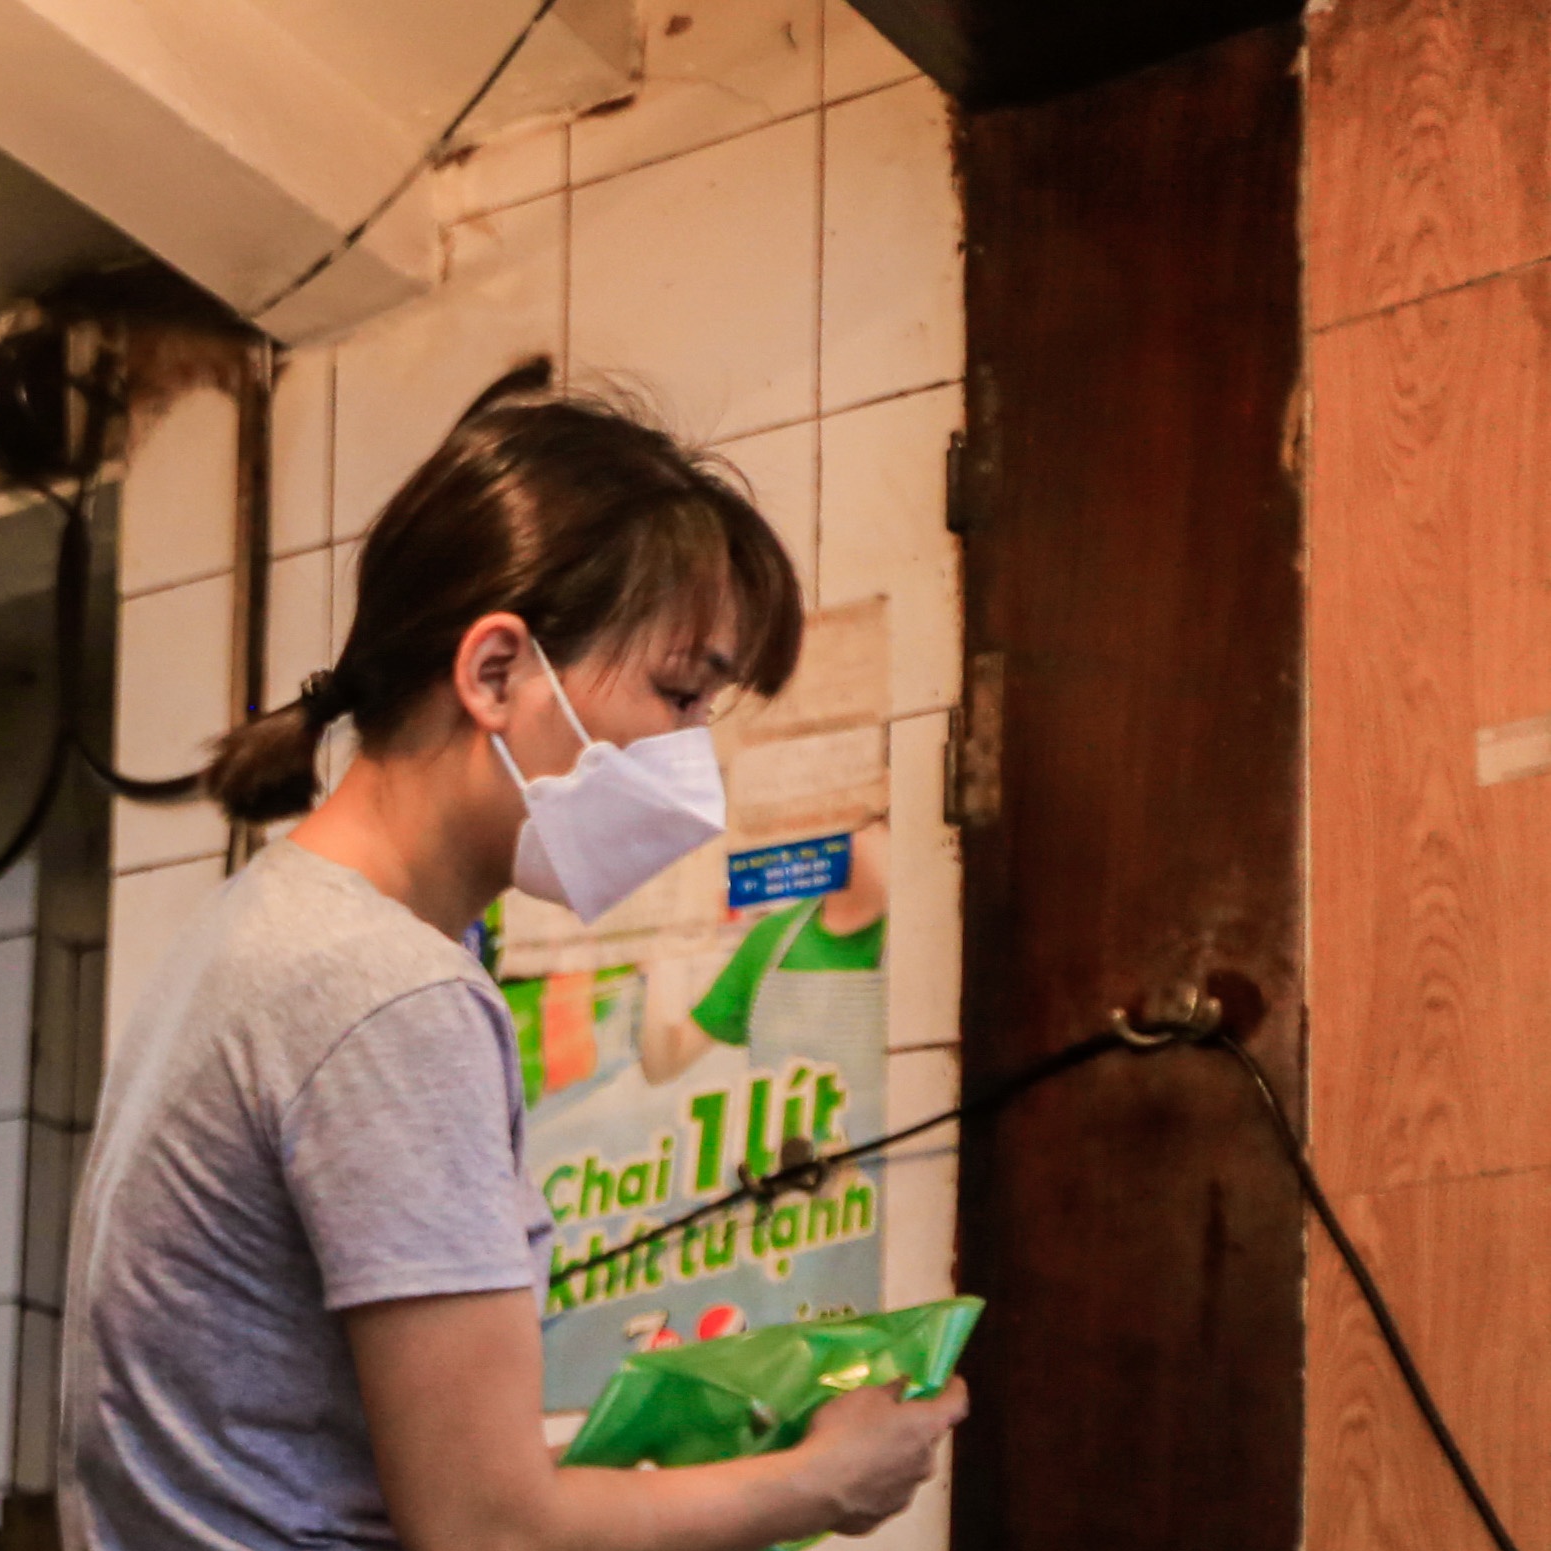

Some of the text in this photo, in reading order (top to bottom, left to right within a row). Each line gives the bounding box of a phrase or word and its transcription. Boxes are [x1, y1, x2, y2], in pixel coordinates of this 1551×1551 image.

[543, 1067, 845, 1222] Chai 1 lít
[750, 1185, 873, 1275] lạnh
